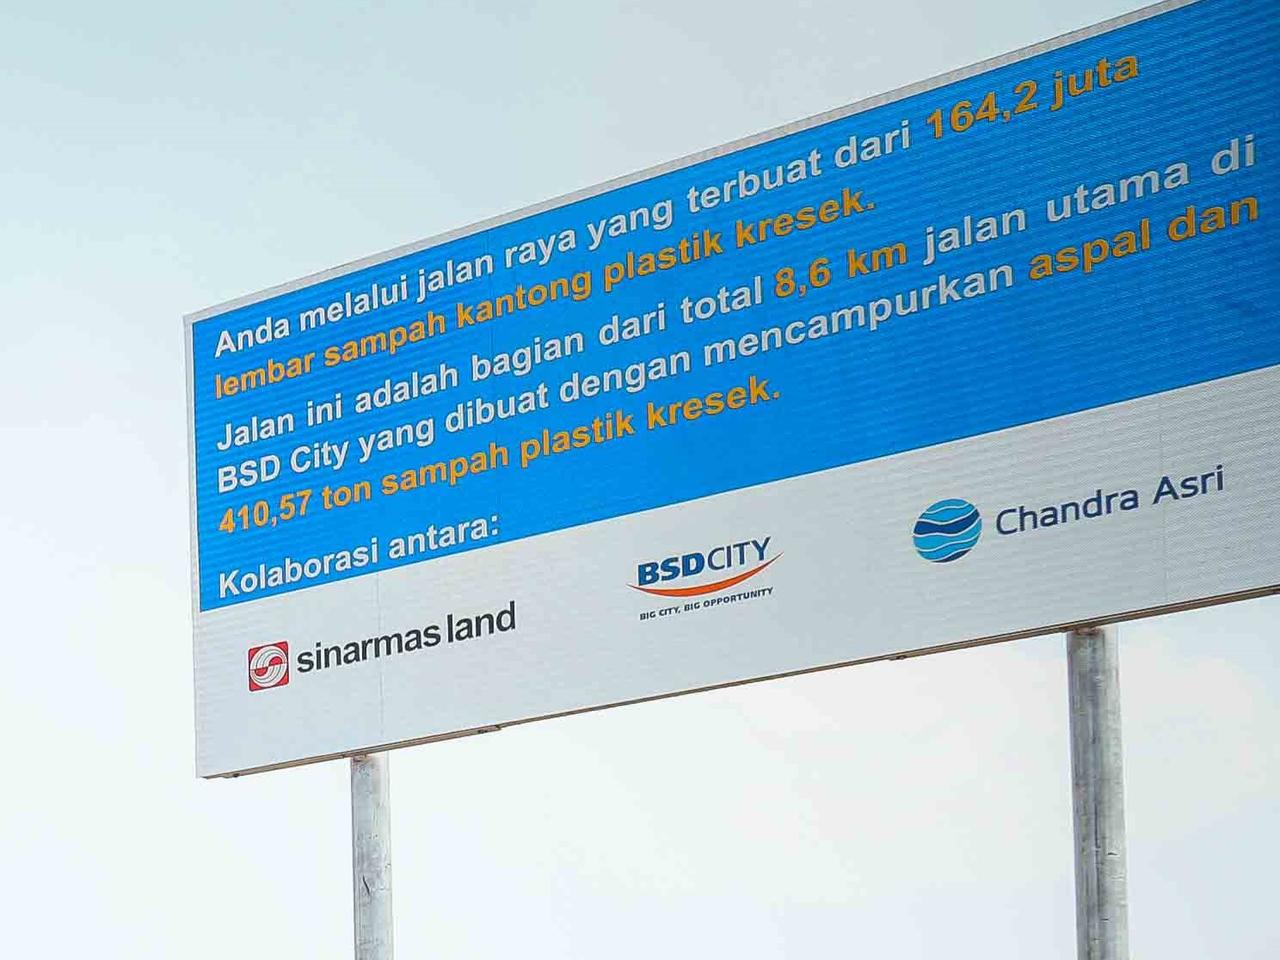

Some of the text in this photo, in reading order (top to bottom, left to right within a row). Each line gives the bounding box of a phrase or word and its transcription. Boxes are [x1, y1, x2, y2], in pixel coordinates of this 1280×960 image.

[215, 55, 1139, 358] Anda melalui jalan raya yang terbuat dari 164,2 juta
[214, 187, 875, 400] lembar sampah kantong plastik kresek.
[217, 134, 1254, 451] Jalan ini adalah bagian dari total 8,6 km jalan utama di
[218, 197, 1258, 493] BSD City yang dibuat dengan mencampurkan aspal dan
[218, 375, 780, 534] 410,57 ton sampah plastik kresek.
[995, 464, 1225, 536] Chandra Asri
[219, 515, 498, 598] Kolaborasi antara:
[639, 586, 773, 621] BIG CITY, BIG OPPORTUNITY
[296, 601, 517, 673] sinarmas land
